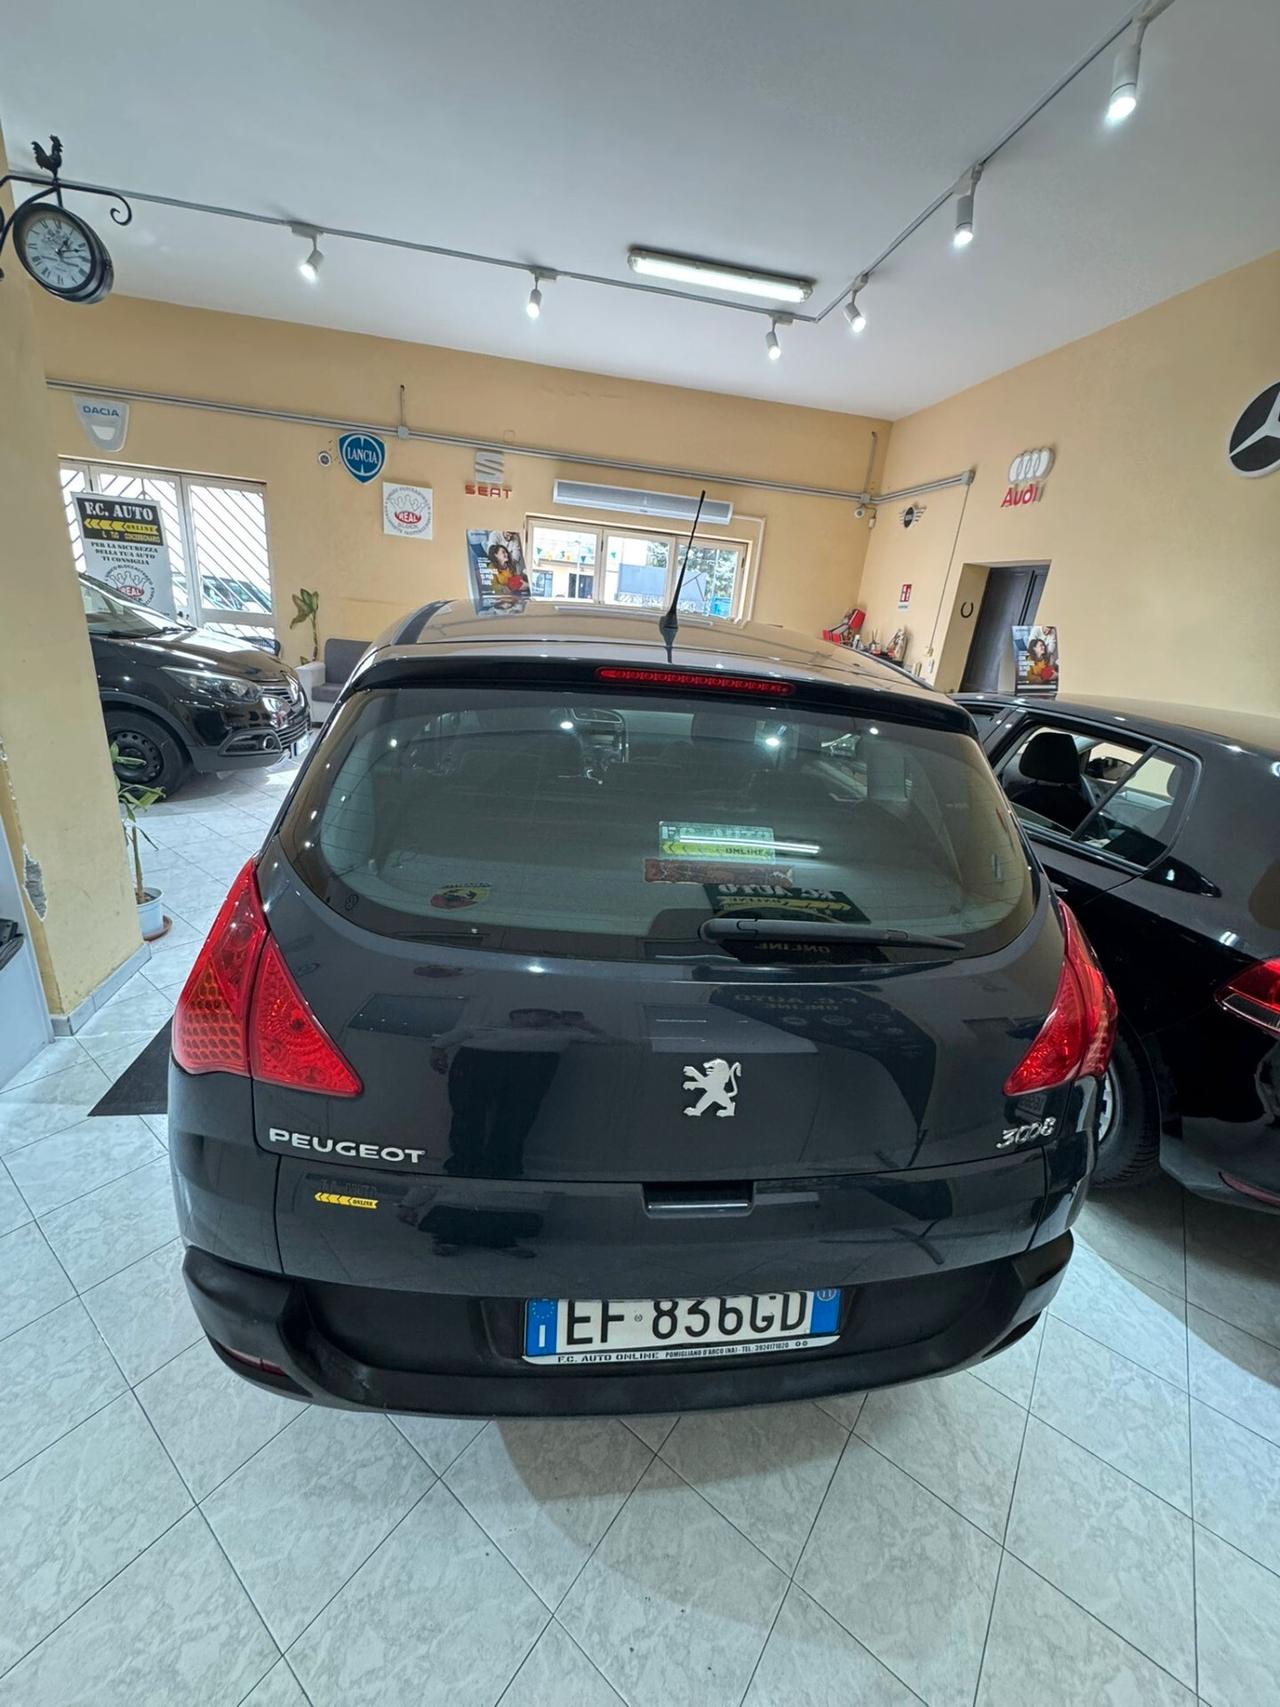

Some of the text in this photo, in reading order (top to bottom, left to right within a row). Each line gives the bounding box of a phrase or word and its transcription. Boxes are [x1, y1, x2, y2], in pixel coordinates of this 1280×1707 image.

[83, 405, 120, 417] DACIA
[346, 447, 378, 464] LANCIA
[465, 484, 512, 499] SEAT
[1000, 483, 1039, 508] Audi
[84, 501, 153, 521] F.C. AUTO
[396, 511, 420, 523] REAL
[126, 523, 155, 533] ONLINE
[91, 541, 106, 549] PER
[118, 544, 158, 553] SICUREZZA
[96, 548, 155, 560] DELLA TUA AUTO
[111, 556, 150, 566] CONSIGLIA
[995, 1116, 1057, 1149] 3008
[269, 1127, 426, 1164] PEUGEOT
[538, 1325, 546, 1347] I
[566, 1299, 625, 1345] EF
[581, 1353, 612, 1362] AUTO
[616, 1351, 659, 1361] ONLINE
